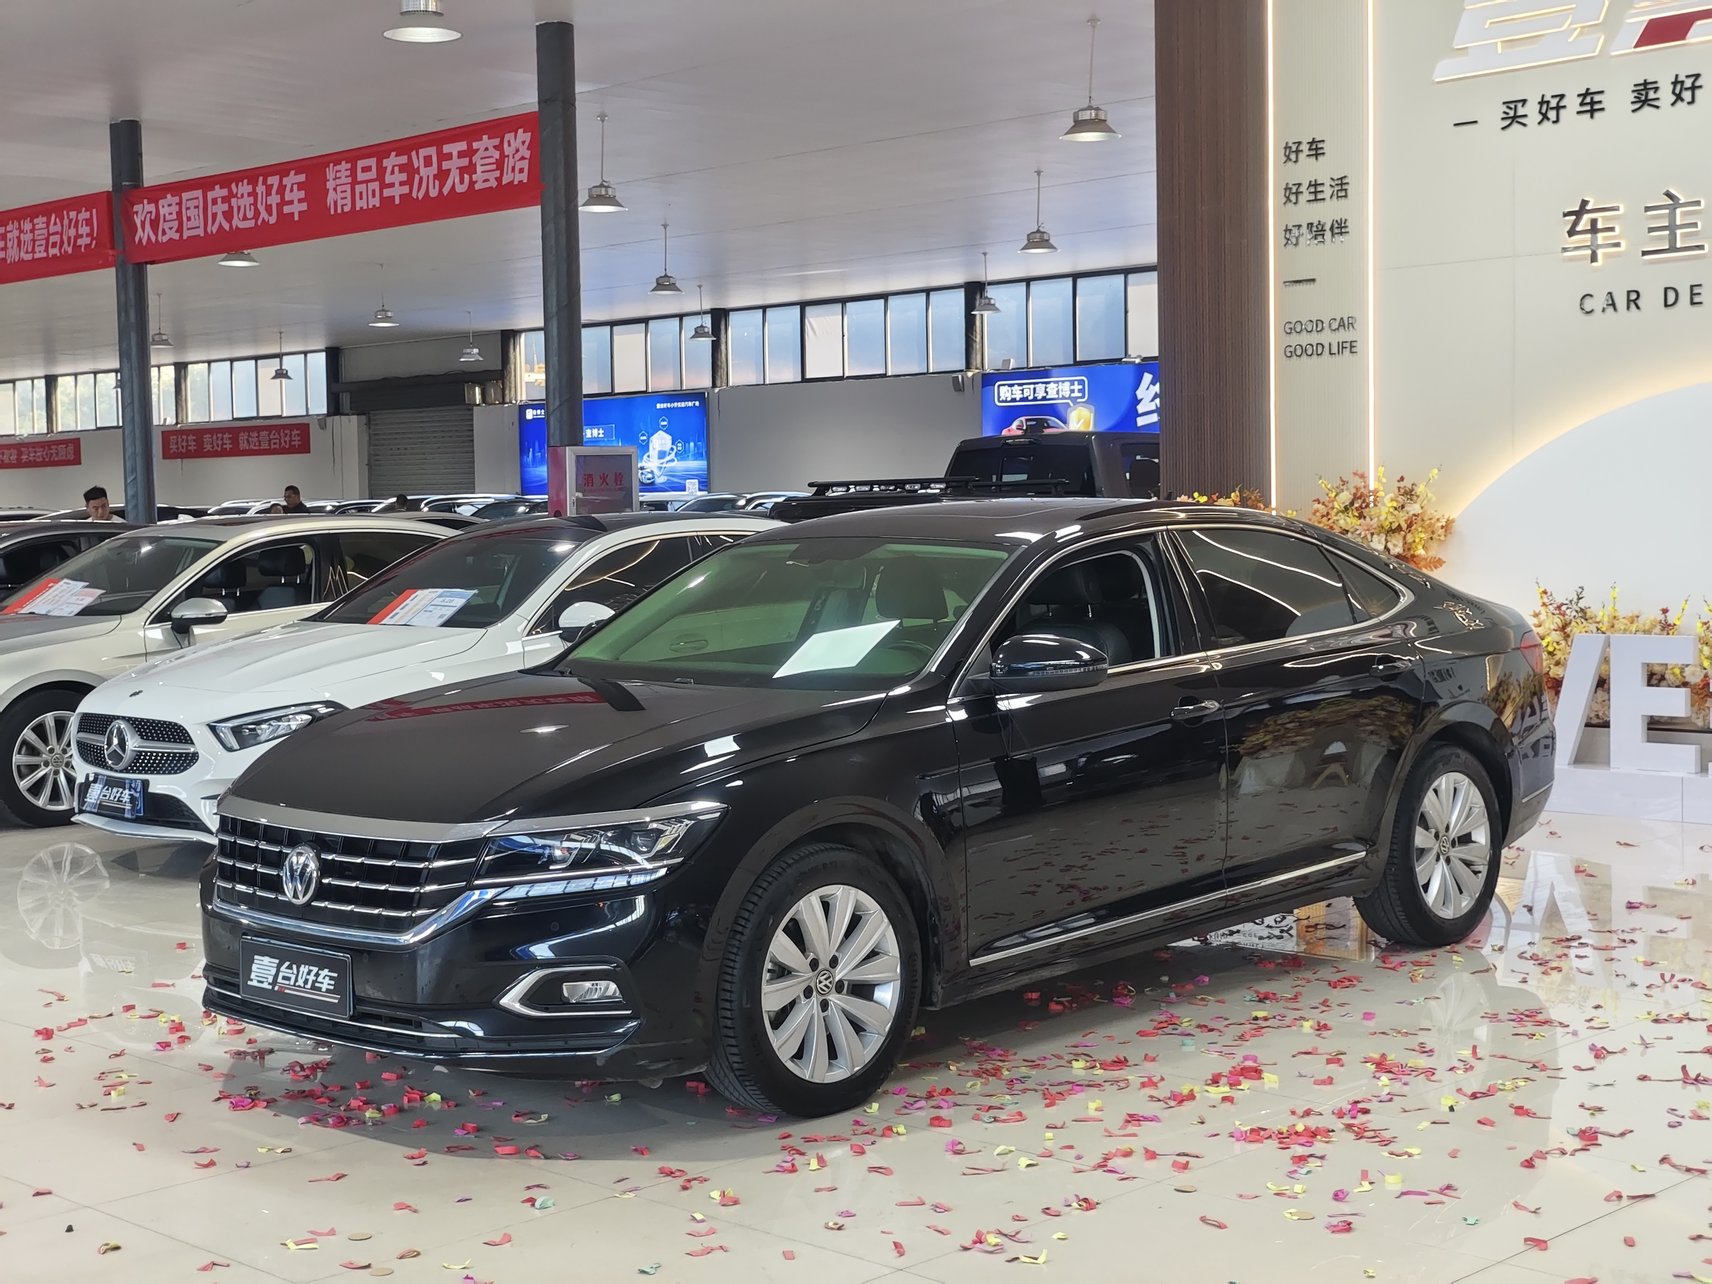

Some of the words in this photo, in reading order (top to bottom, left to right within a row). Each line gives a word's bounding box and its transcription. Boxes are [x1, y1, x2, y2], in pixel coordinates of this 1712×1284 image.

[1501, 87, 1606, 131] 买好车
[1630, 73, 1704, 113] 卖好
[1283, 137, 1327, 165] 好车
[132, 169, 309, 246] 欢度国庆选好车
[325, 127, 533, 216] 精品车况无套路
[1283, 175, 1350, 206] 好生活
[1283, 217, 1350, 248] 好陪伴
[1560, 188, 1708, 266] 车主
[1579, 288, 1642, 316] CAR
[1663, 283, 1705, 309] DE
[1283, 319, 1325, 335] GOOD
[1328, 316, 1358, 332] CAR
[1283, 342, 1325, 359] GOOD
[1328, 340, 1358, 356] LIFE
[999, 381, 1084, 402] 购车可享查博士
[169, 434, 198, 454] 买好车
[203, 432, 233, 453] 卖好车
[238, 428, 302, 451] 就选壹台好车
[583, 471, 624, 488] 消火栓
[247, 954, 339, 993] 壹台好车
